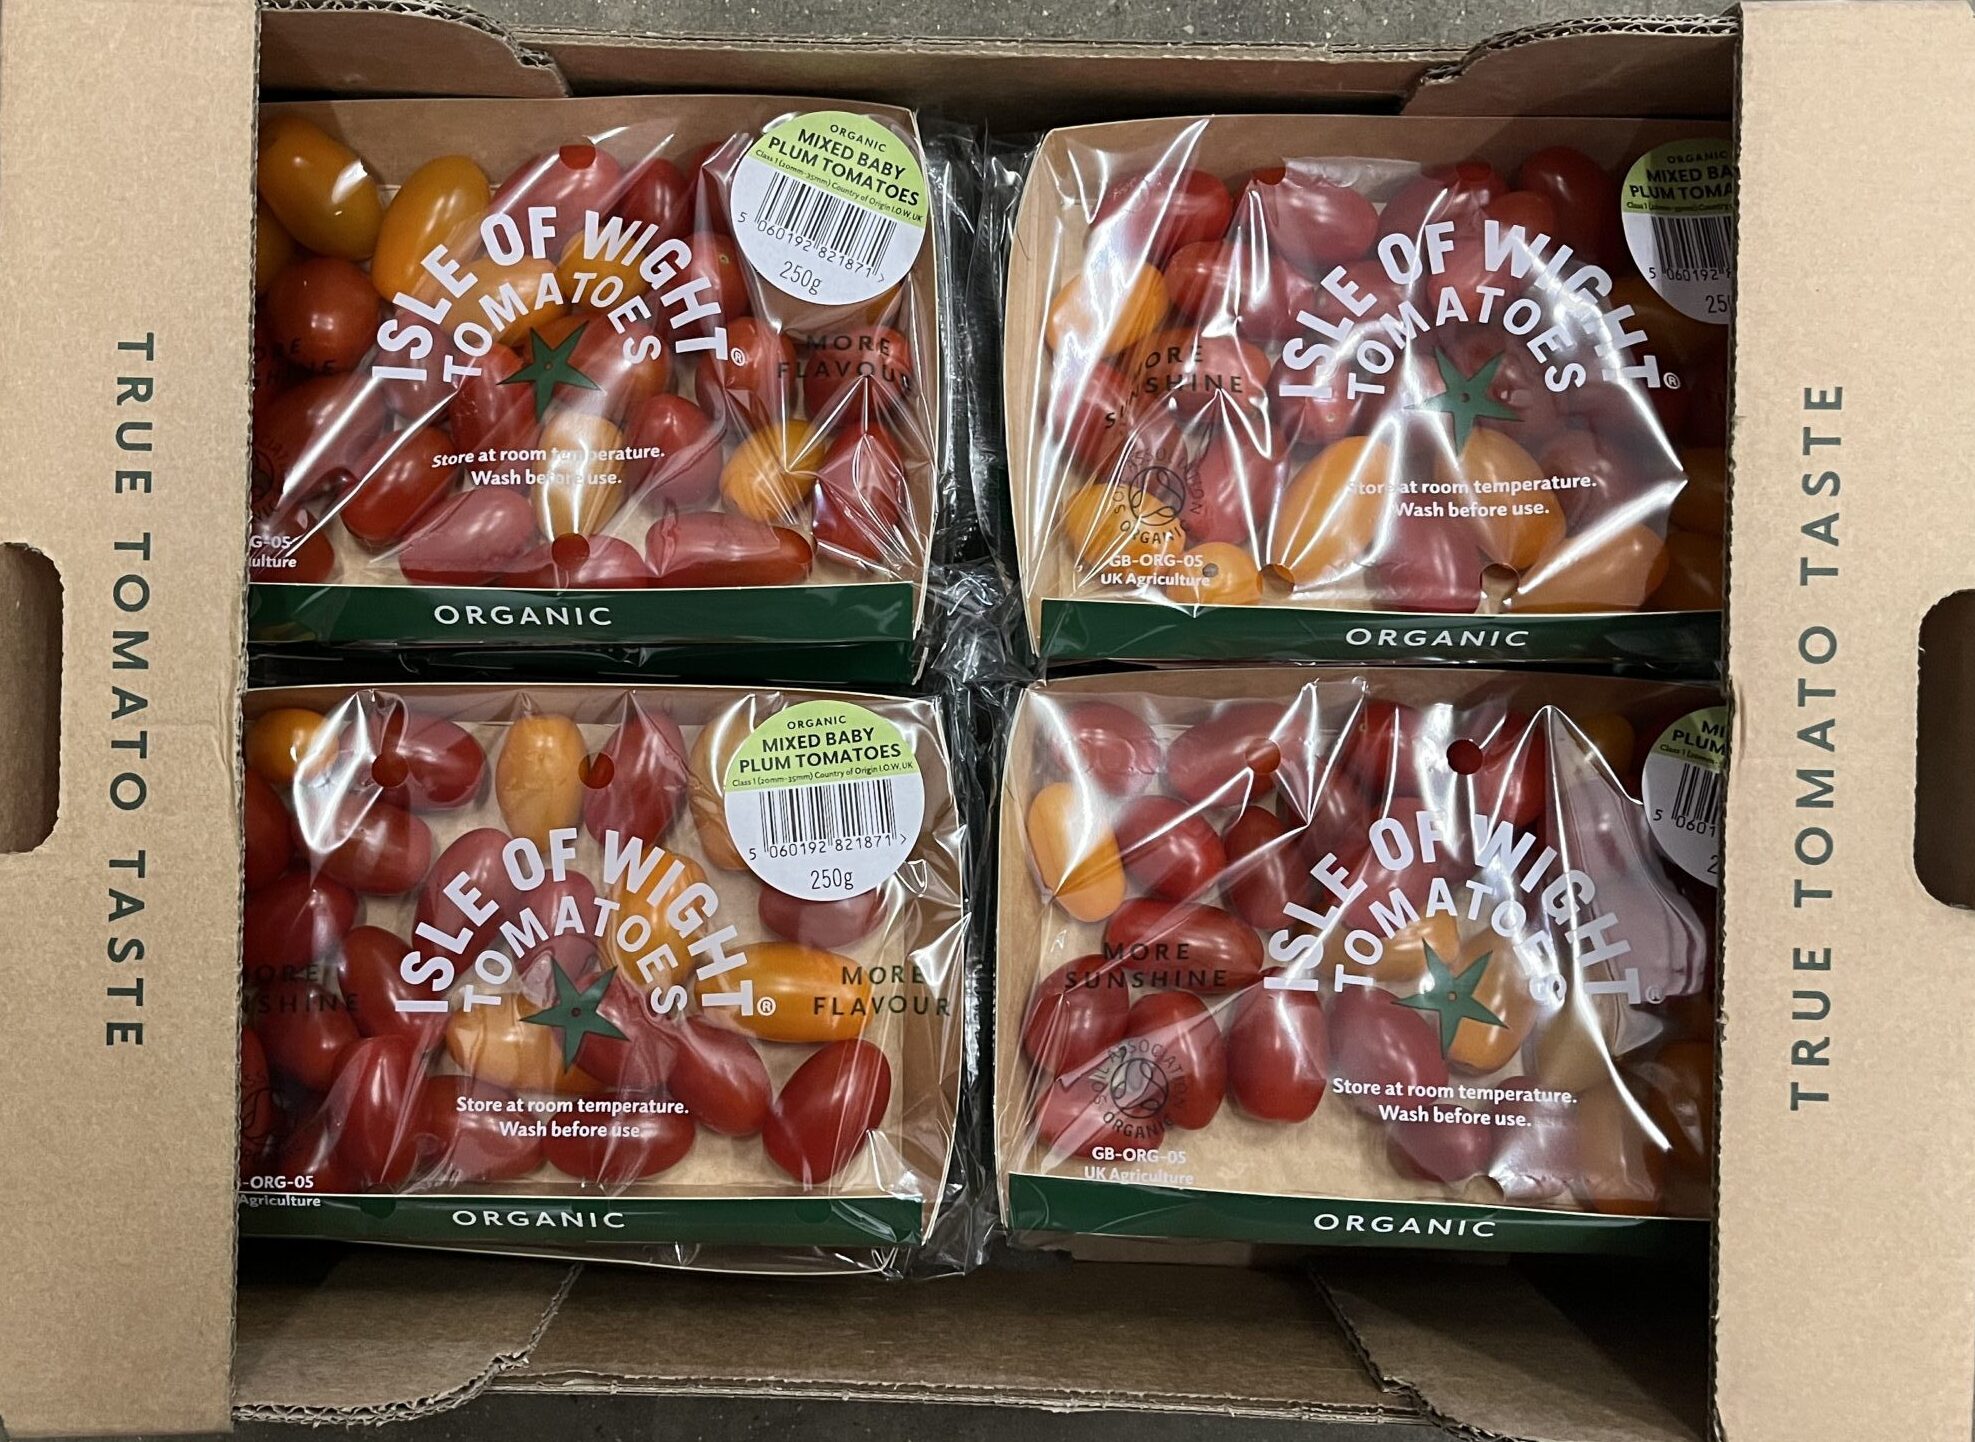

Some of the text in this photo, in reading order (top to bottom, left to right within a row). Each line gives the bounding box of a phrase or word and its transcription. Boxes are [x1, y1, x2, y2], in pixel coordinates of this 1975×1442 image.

[830, 124, 887, 153] ORGANIC
[798, 128, 906, 180] MIXED BABY
[1667, 151, 1728, 164] ORGANIC
[755, 149, 774, 162] Class
[831, 182, 860, 200] Country
[860, 193, 869, 202] of
[869, 196, 891, 213] Origin
[768, 136, 920, 207] PLUM TOMATOES
[1646, 166, 1734, 183] MIXED BA
[1629, 183, 1733, 200] PLUM TOMA
[738, 211, 748, 223] 5
[757, 220, 813, 252] 060192
[818, 246, 872, 278] 821871
[779, 260, 822, 296] 250g
[1649, 267, 1656, 280] 5
[1667, 269, 1719, 282] 060192
[371, 243, 479, 382] ISLE
[480, 206, 557, 266] OF
[1705, 294, 1732, 314] 25
[1279, 265, 1378, 399] ISLE
[1377, 220, 1455, 285] OF
[443, 272, 662, 383] TOMATOES
[806, 335, 890, 357] MORE
[1347, 285, 1586, 399] TOMATOES
[1137, 345, 1203, 375] ORE
[431, 445, 665, 469] Store at room teerature.
[471, 469, 521, 486] Wash
[588, 473, 622, 486] use.
[1400, 481, 1418, 494] at
[1421, 482, 1469, 494] room
[1473, 475, 1597, 496] temperature.
[1396, 502, 1550, 517] Wash before use.
[249, 554, 298, 568] ulture
[1109, 553, 1204, 568] GB-ORG-05
[1101, 572, 1211, 588] UK Agriculture
[433, 605, 613, 626] ORGANIC
[1345, 628, 1529, 647] ORGANIC
[106, 332, 154, 1046] TRUE TOMATO TASTE
[787, 715, 847, 730] ORGANIC
[763, 727, 875, 753] MIXED BABY
[1672, 729, 1726, 755] PLUM
[1790, 386, 1843, 1112] TRUE TOMATO TASTE
[740, 743, 901, 773] PLUM TOMATOES
[732, 779, 752, 788] Class
[814, 769, 844, 780] Country
[846, 767, 854, 776] of
[855, 765, 878, 777] Origin
[1653, 809, 1717, 838] 5 0601
[749, 848, 758, 861] 5
[770, 841, 827, 858] 060192
[835, 834, 893, 851] 821871
[810, 868, 854, 890] 250g
[1263, 852, 1368, 992] ISLE
[1369, 810, 1445, 871] OF
[395, 871, 499, 1013] ISLE
[502, 827, 577, 891] OF
[1104, 943, 1190, 961] MORE
[1334, 877, 1567, 1005] TOMATOES
[463, 896, 688, 1014] TOMATOES
[842, 966, 925, 985] MORE
[1064, 969, 1227, 990] SUNSHINE
[814, 996, 951, 1016] FLAVOUR
[1333, 1077, 1578, 1105] Store at room temperature.
[456, 1096, 689, 1116] Store at room temperature.
[1379, 1104, 1532, 1127] Wash before use.
[499, 1121, 547, 1137] Wash
[551, 1120, 607, 1137] before
[1092, 1146, 1187, 1164] GB-ORG-05
[240, 1175, 314, 1190] -ORG-05
[1085, 1166, 1195, 1185] UK Agriculture
[452, 1210, 625, 1228] ORGANIC
[1313, 1213, 1496, 1238] ORGANIC
